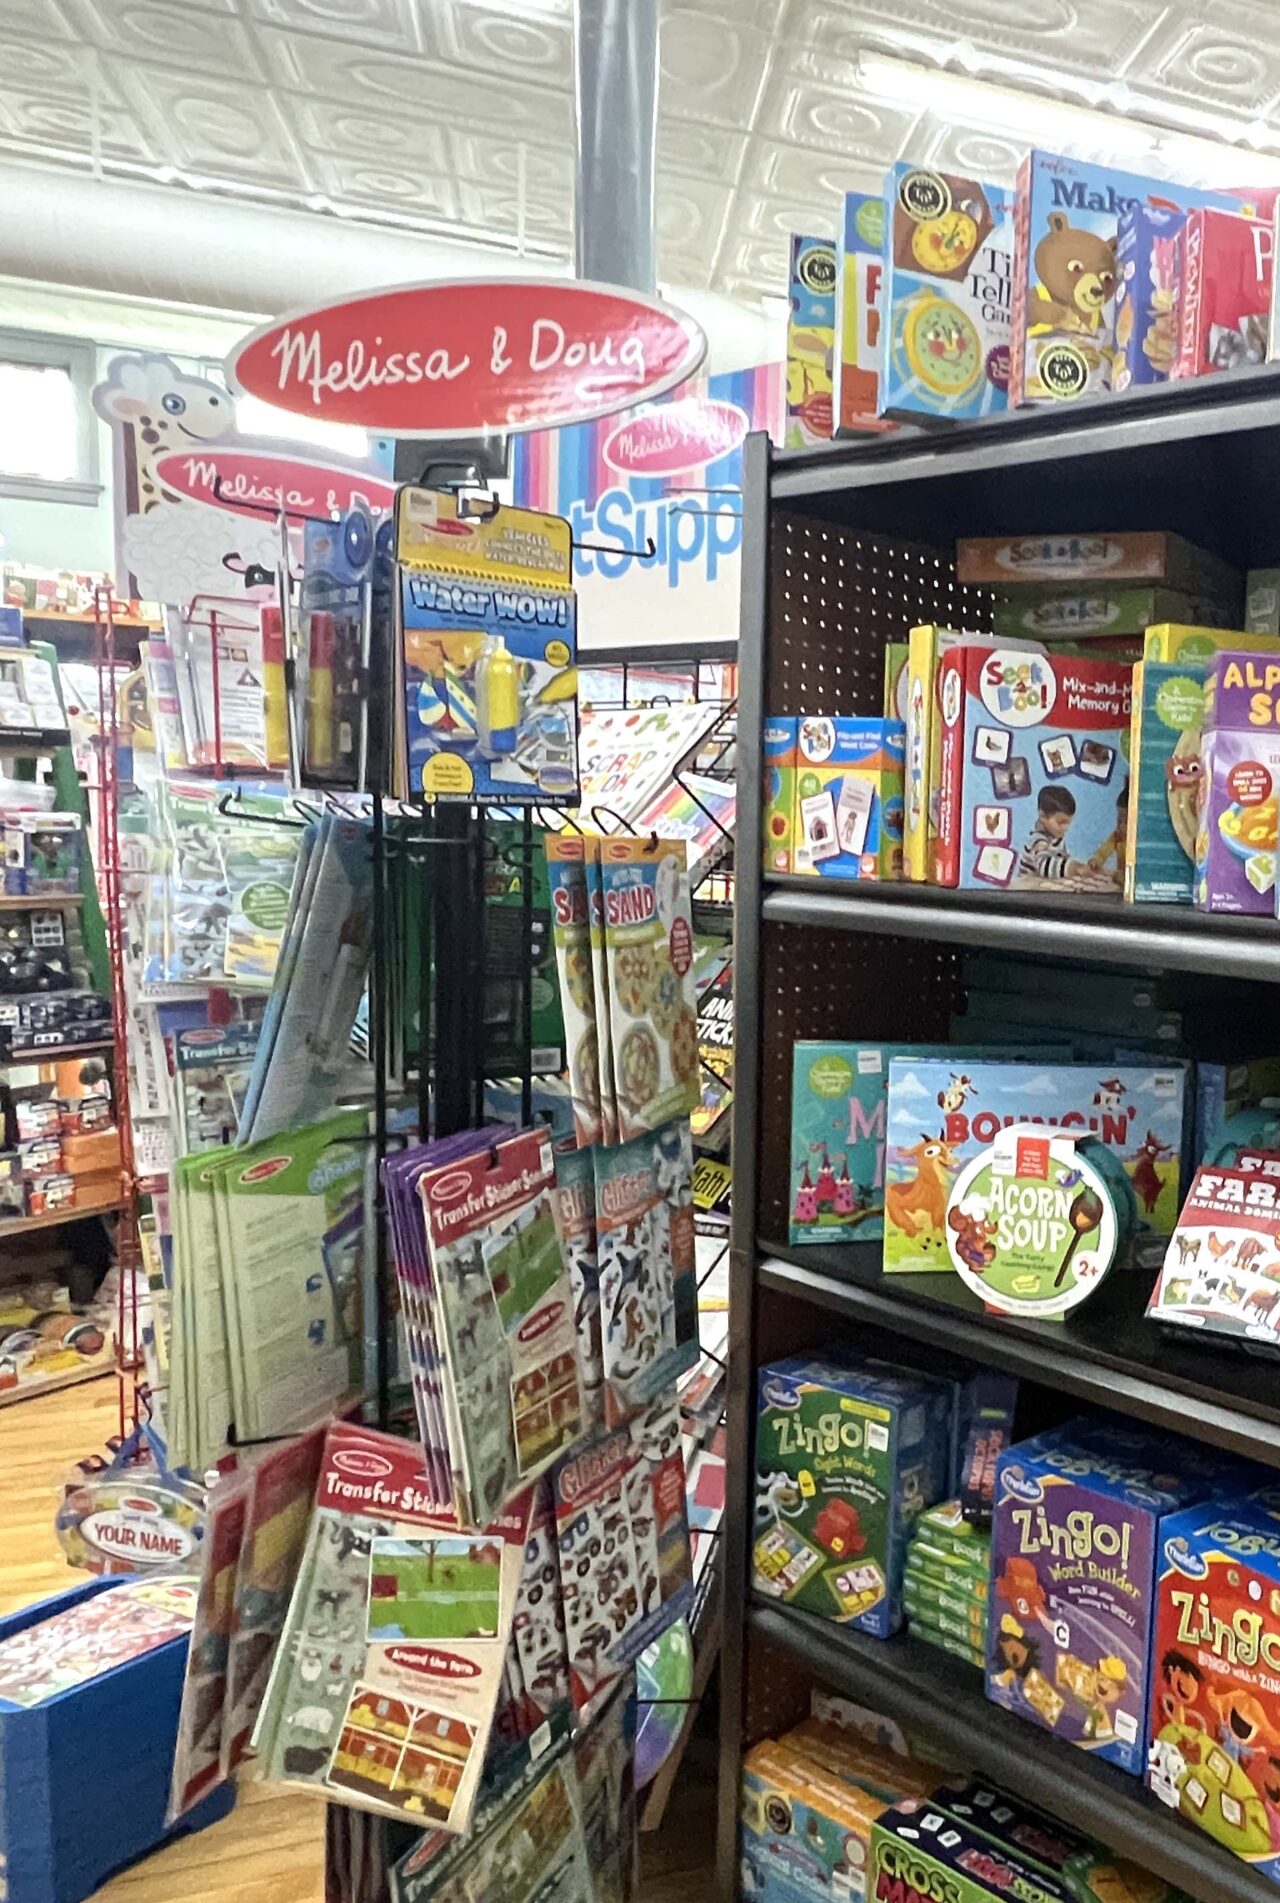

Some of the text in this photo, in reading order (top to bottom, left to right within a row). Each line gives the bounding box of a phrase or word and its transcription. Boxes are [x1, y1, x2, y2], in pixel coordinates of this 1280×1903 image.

[983, 247, 1011, 278] Ti
[970, 273, 1011, 311] Tell
[271, 318, 646, 404] Melissa & Doug
[619, 433, 680, 464] Melissa
[182, 457, 341, 511] Melissa &
[409, 579, 568, 628] Water WOW!
[986, 660, 1043, 686] Seek
[1062, 675, 1131, 697] Mix-and-M
[1068, 693, 1119, 715] Memory
[581, 750, 658, 774] SCRAP
[606, 883, 656, 926] SAND
[701, 997, 733, 1019] ANI
[181, 1043, 235, 1060] Transfer
[434, 1190, 487, 1231] Transfer
[989, 1176, 1074, 1220] ACORN
[1189, 1198, 1241, 1215] ANIMAL
[997, 1213, 1068, 1253] SOUP
[1079, 1259, 1099, 1279] 2+
[772, 1412, 871, 1459] Zingo!
[842, 1456, 877, 1478] Words
[325, 1472, 400, 1506] Transfer
[94, 1523, 183, 1556] YOUR NAME
[1012, 1506, 1131, 1570] Zingo!
[1048, 1561, 1142, 1599] Word Builder
[1056, 1626, 1067, 1643] C
[391, 1649, 427, 1667] Around
[429, 1654, 447, 1671] the
[1198, 1650, 1230, 1675] BINGO
[878, 1843, 961, 1903] CROSS
